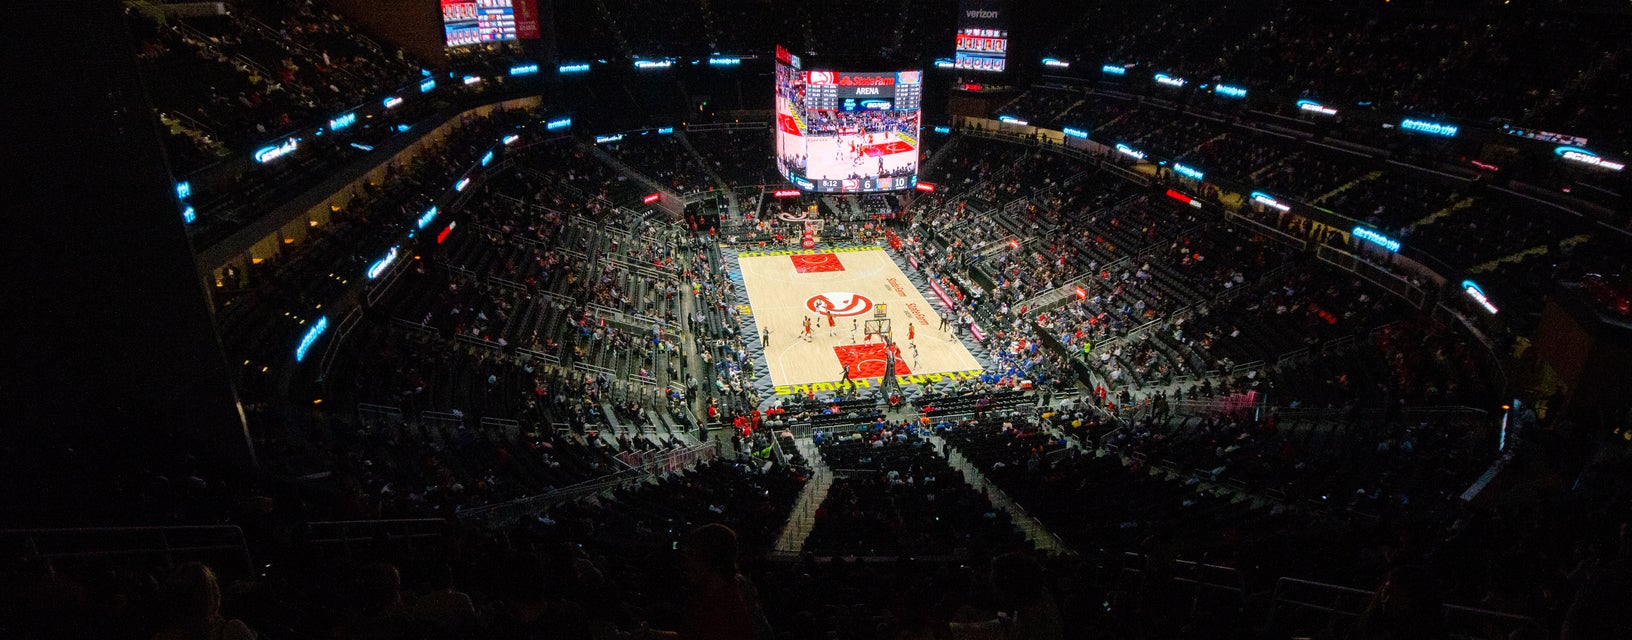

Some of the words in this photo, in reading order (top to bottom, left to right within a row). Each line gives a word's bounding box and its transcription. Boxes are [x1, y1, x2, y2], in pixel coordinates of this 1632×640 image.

[966, 9, 998, 18] verizon
[856, 87, 879, 95] ARENA
[864, 180, 871, 189] 6
[895, 178, 904, 187] 10
